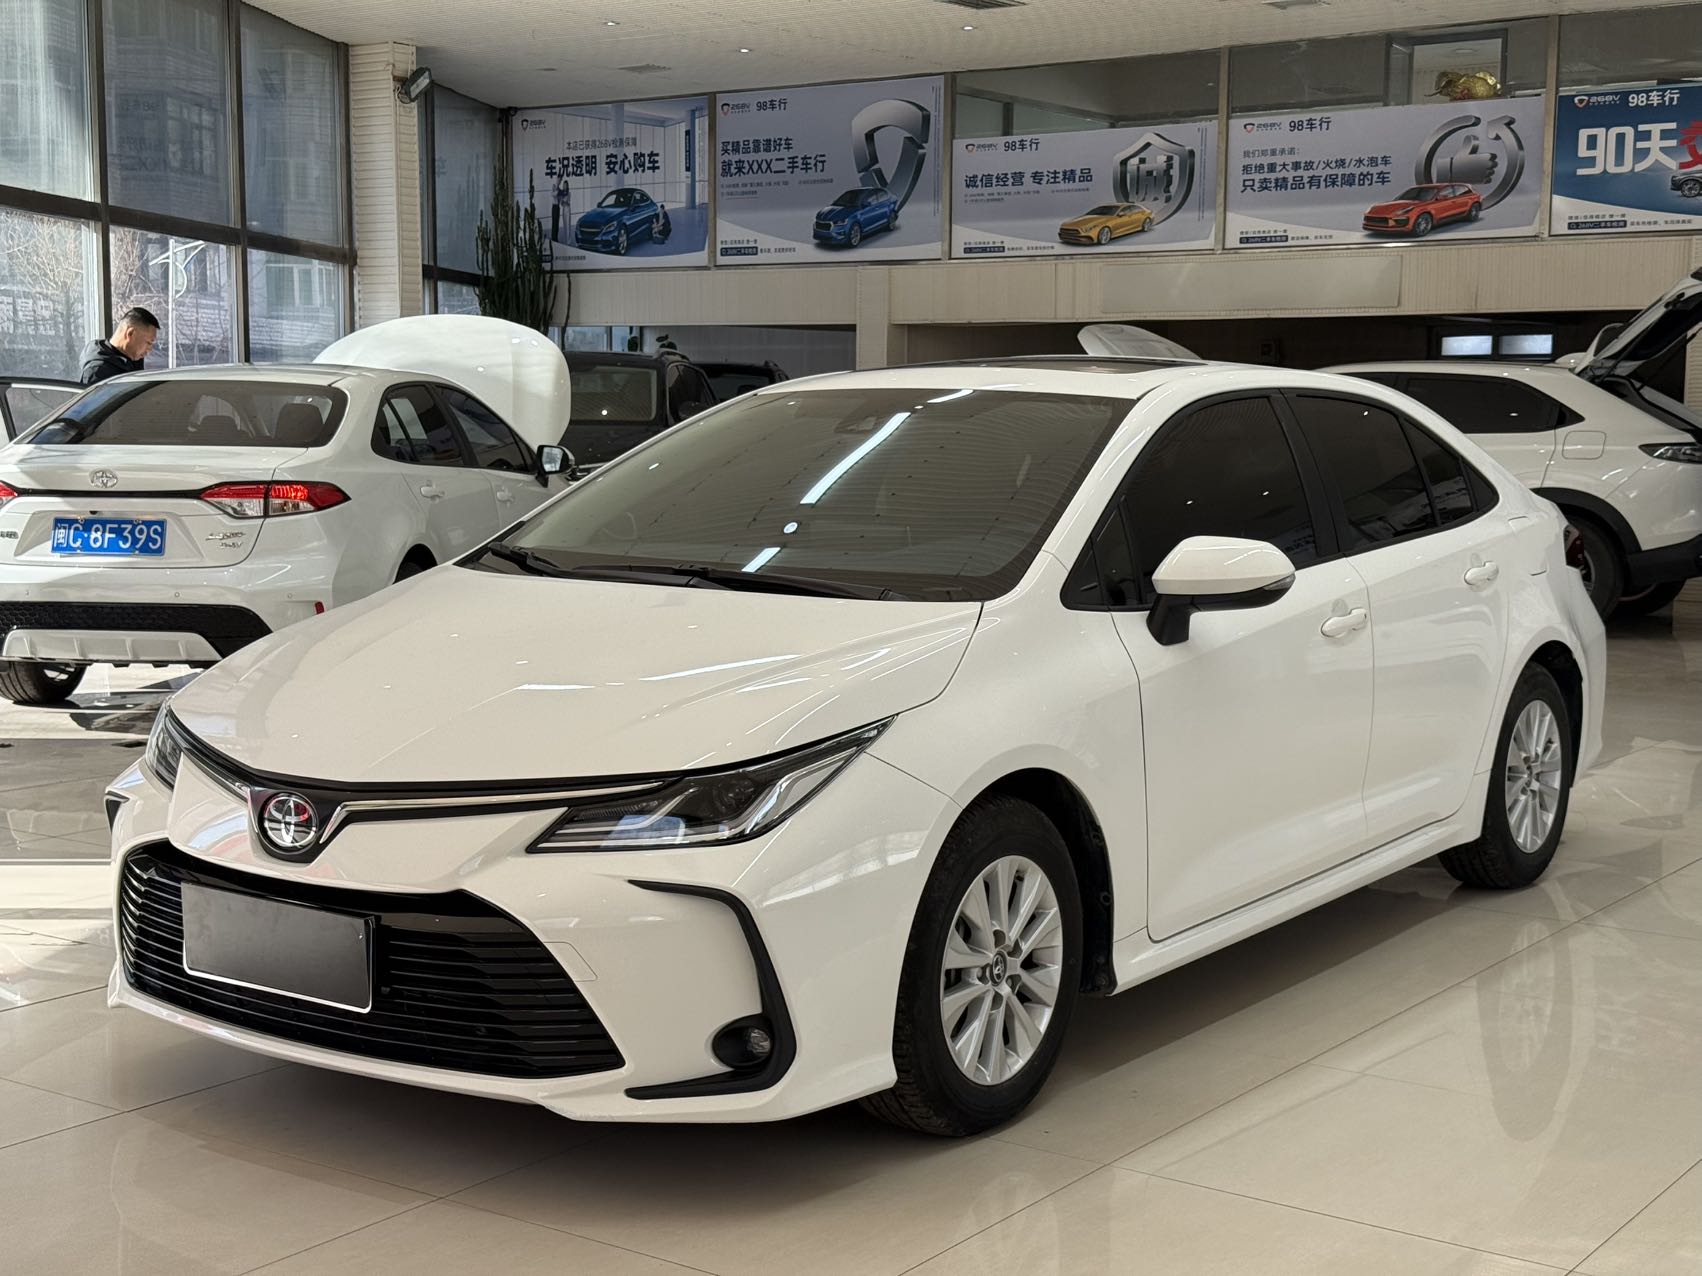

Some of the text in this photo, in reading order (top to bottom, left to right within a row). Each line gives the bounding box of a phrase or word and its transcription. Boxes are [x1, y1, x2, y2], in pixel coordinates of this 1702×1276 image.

[756, 98, 788, 112] 98车行
[1628, 89, 1680, 107] 98车行
[1289, 116, 1332, 132] 98车行
[566, 136, 637, 151] 本店已获得268V检测保障
[720, 137, 793, 156] 买精品靠谱好车
[1003, 138, 1040, 152] 98车行
[545, 155, 597, 178] 车况透明
[605, 151, 660, 175] 安心购车
[720, 153, 826, 178] 就来XXX二手车行
[1241, 155, 1392, 176] 拒绝重大事故/火烧/水泡车
[964, 168, 1093, 189] 诚信经营 专注精品
[1240, 170, 1391, 193] 只卖精品有保障的车
